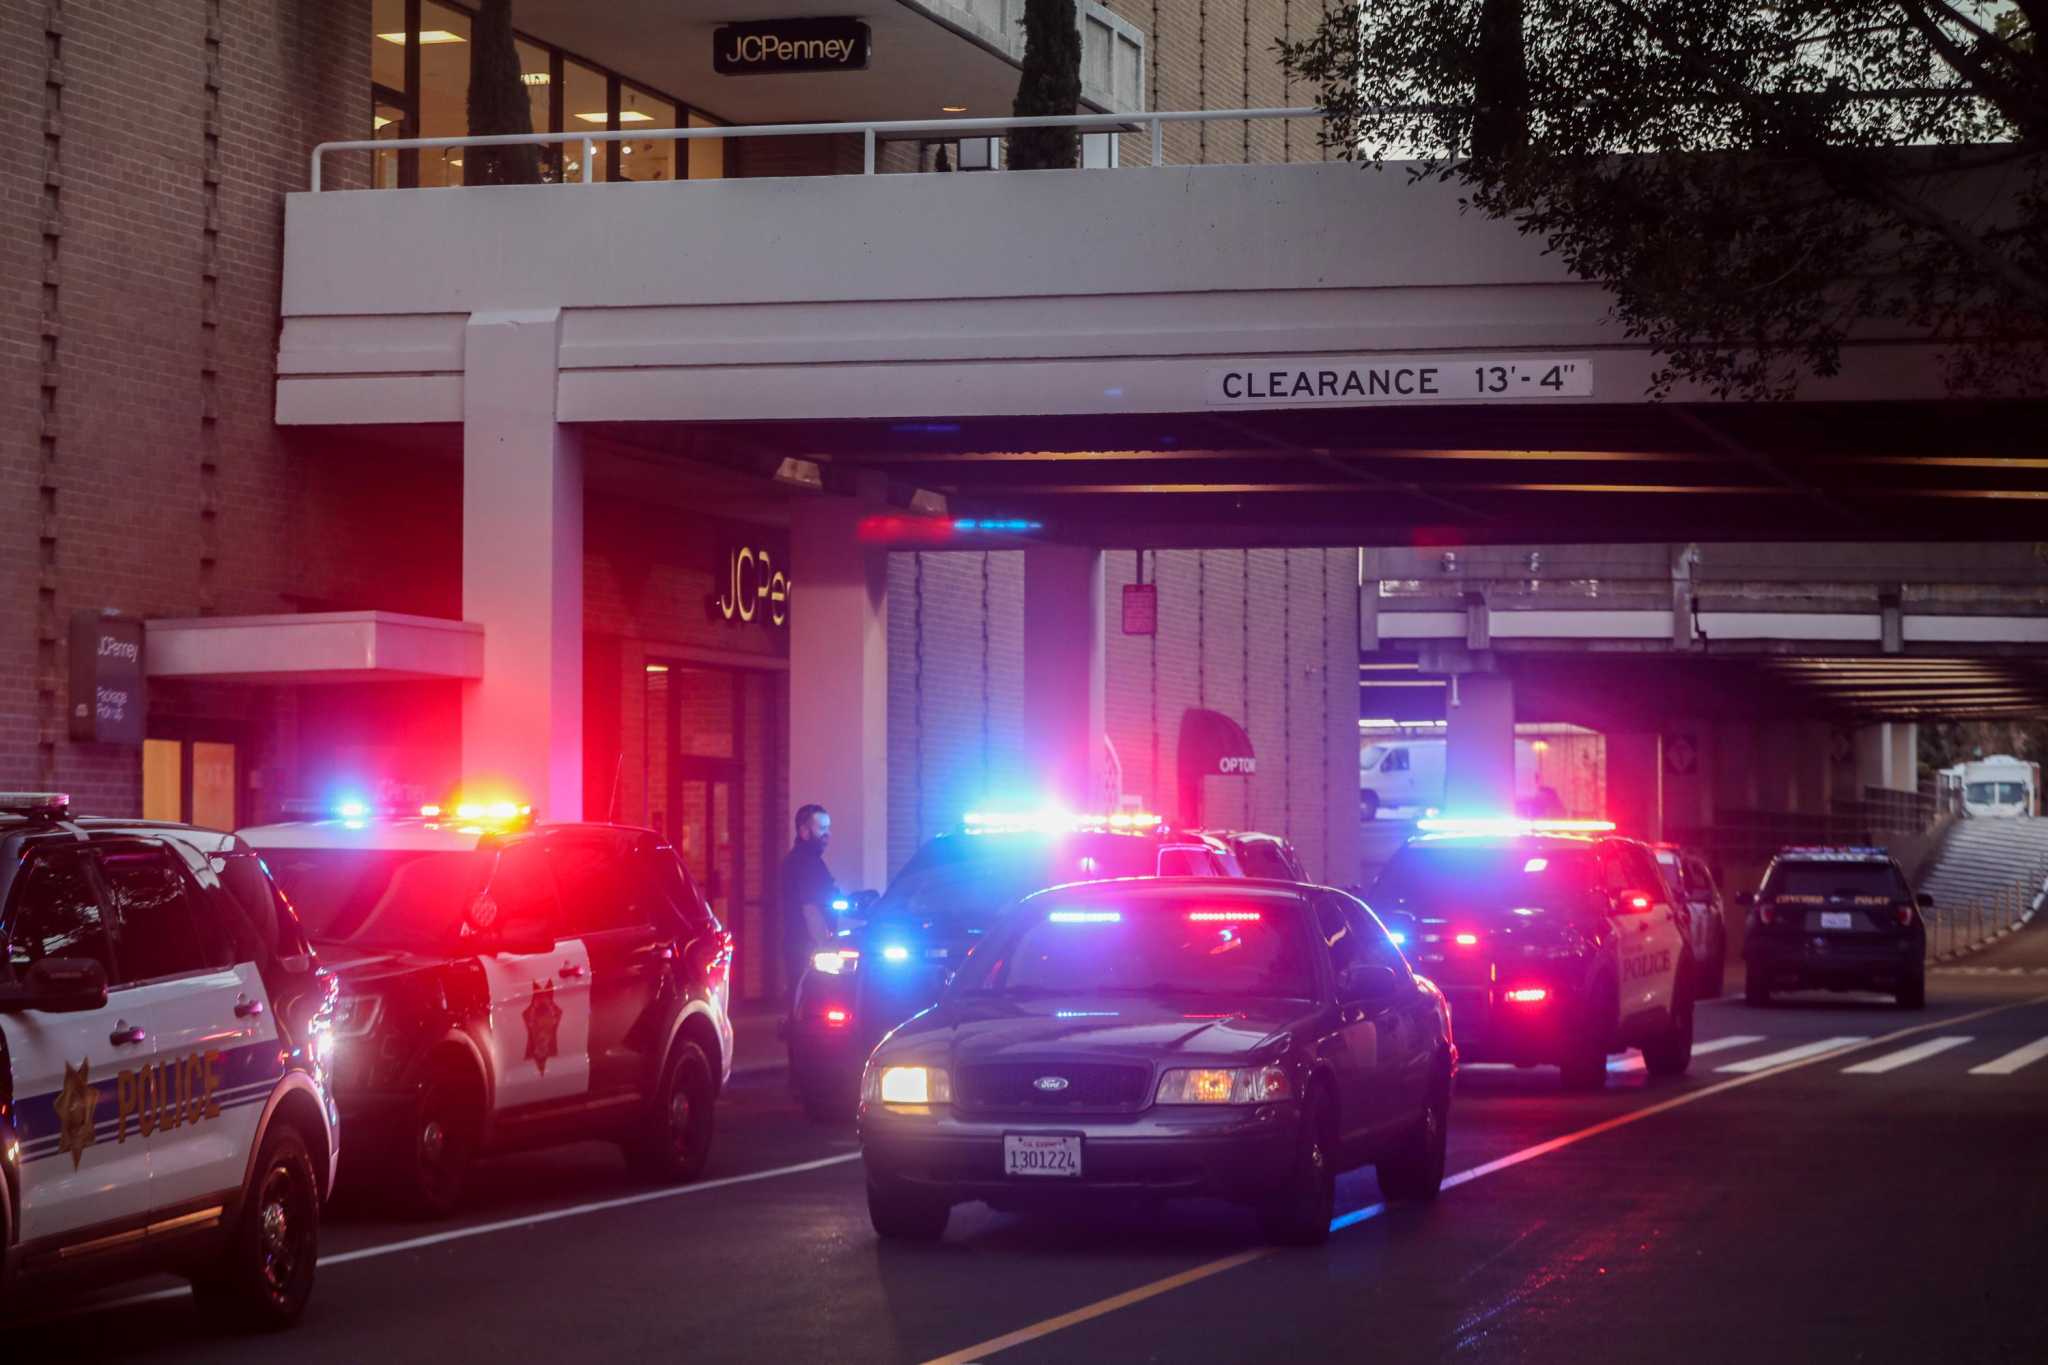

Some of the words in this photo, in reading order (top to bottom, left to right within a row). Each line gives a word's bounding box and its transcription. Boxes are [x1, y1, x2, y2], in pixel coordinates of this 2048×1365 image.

[726, 35, 854, 62] JCPenney
[1222, 368, 1438, 398] CLEARANCE
[721, 547, 791, 626] JCPe
[1623, 949, 1671, 982] POLICE
[118, 1049, 222, 1145] POLICE
[1010, 1150, 1076, 1170] 1301224
